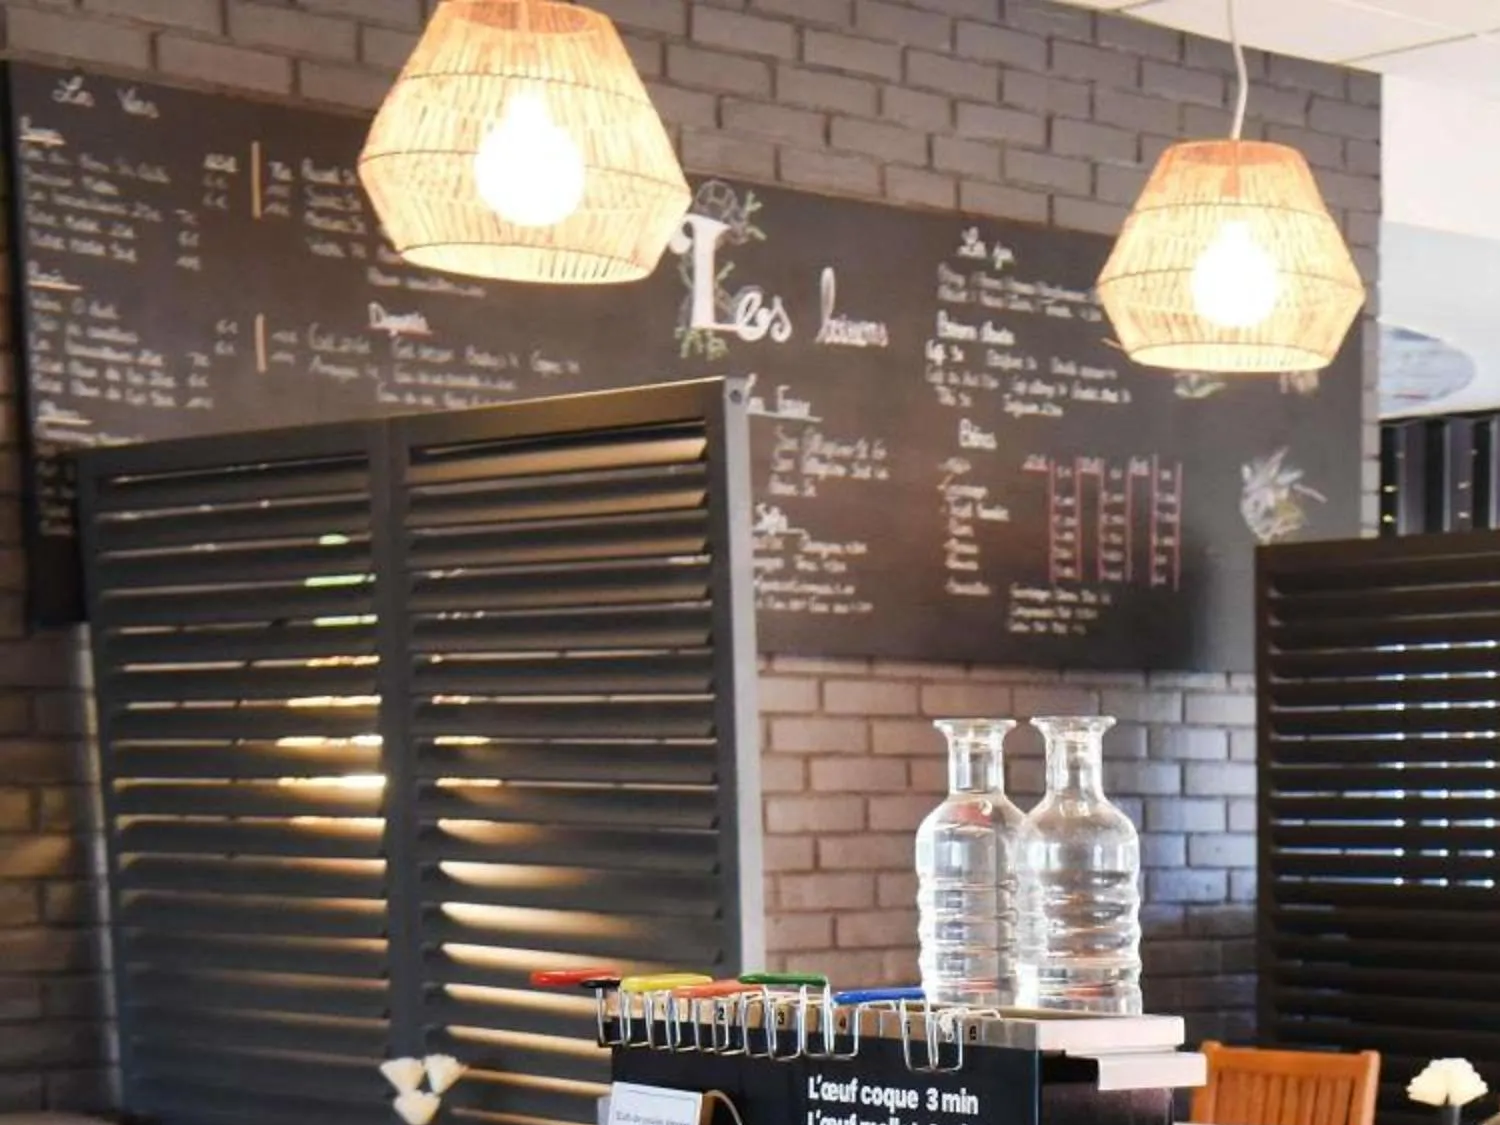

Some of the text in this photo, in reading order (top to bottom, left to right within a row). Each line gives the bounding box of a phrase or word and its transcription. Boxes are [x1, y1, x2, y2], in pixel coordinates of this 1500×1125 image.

[669, 213, 792, 343] Les
[861, 1084, 919, 1114] coque
[926, 1087, 938, 1112] 3
[942, 1088, 979, 1115] min
